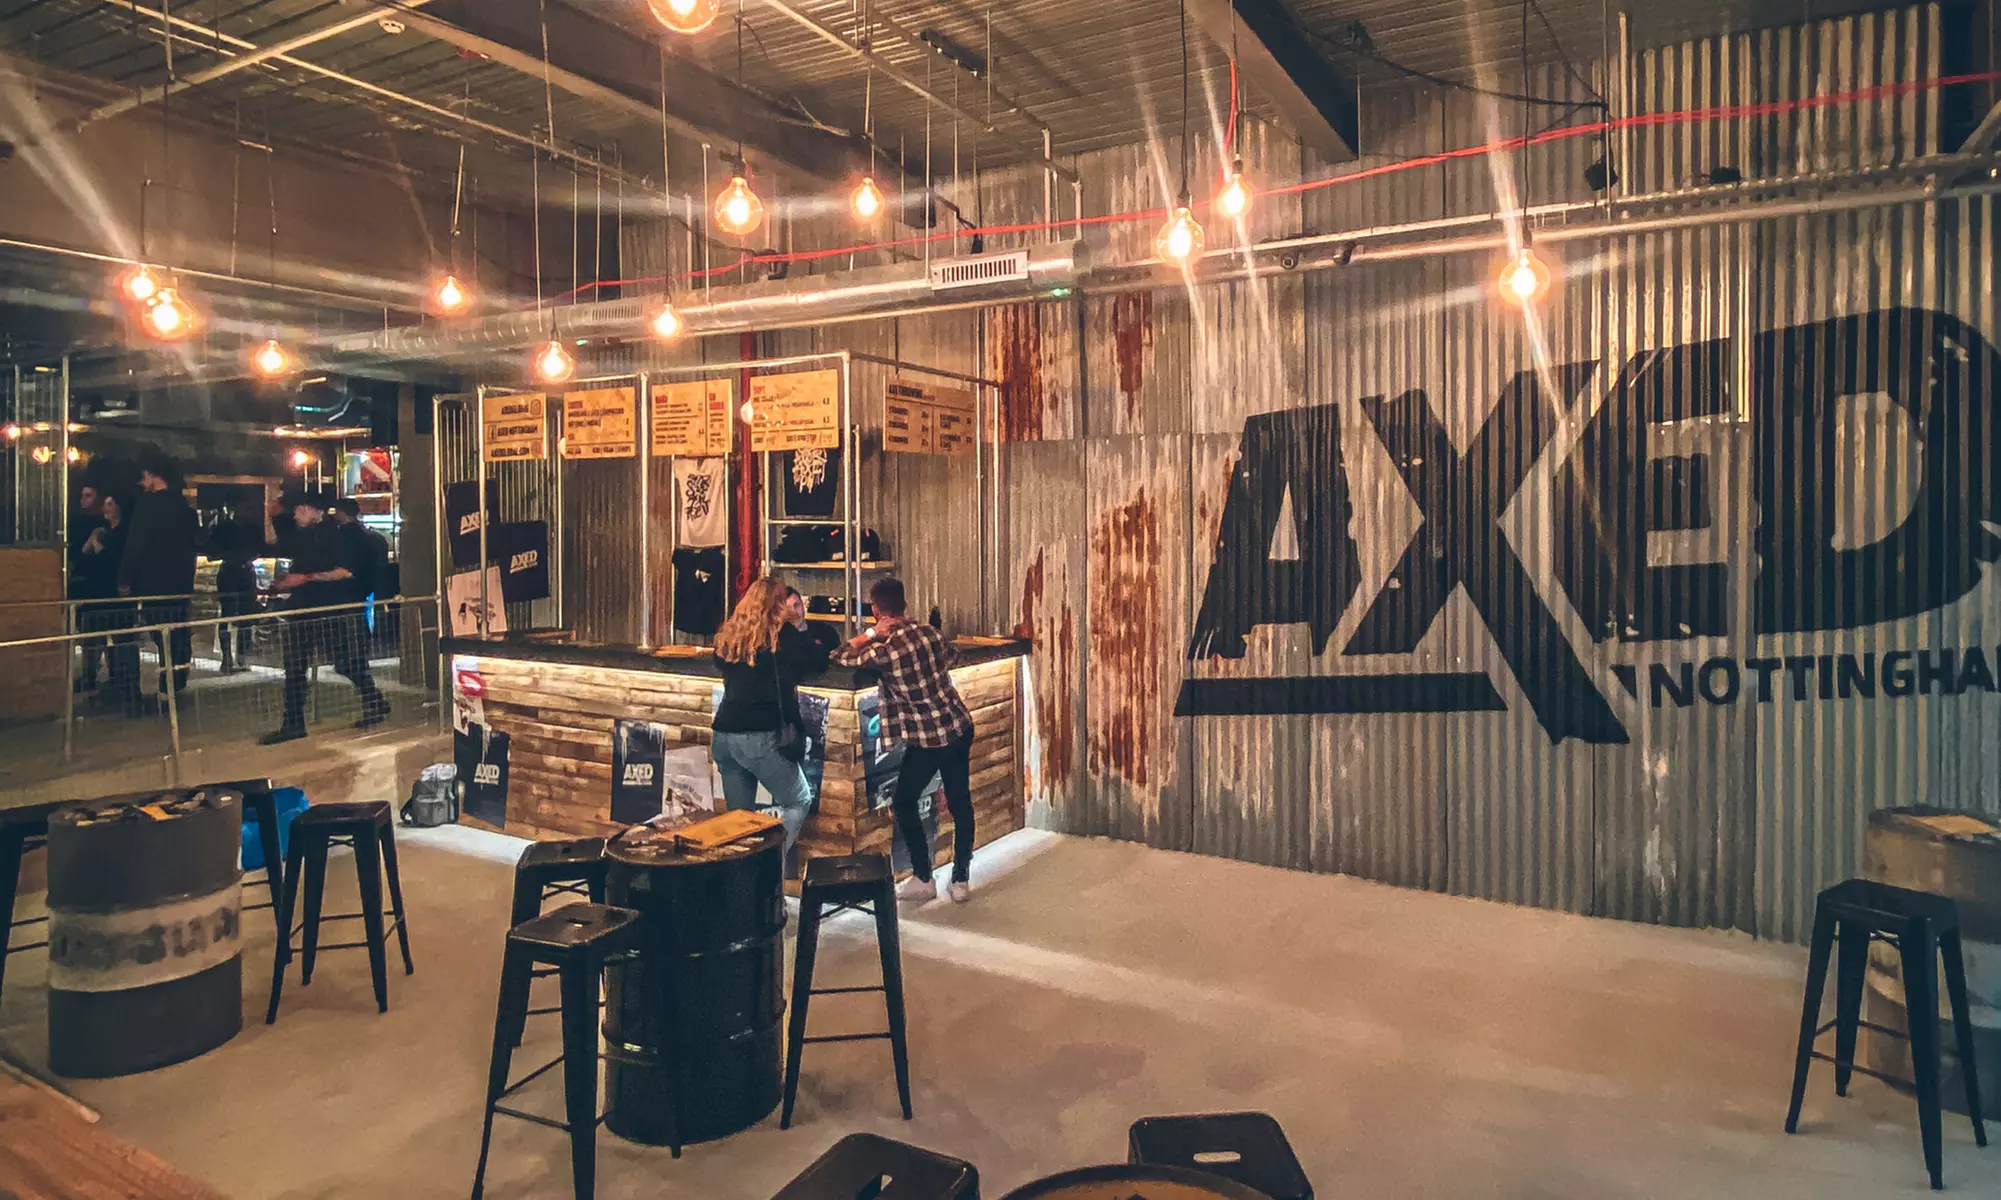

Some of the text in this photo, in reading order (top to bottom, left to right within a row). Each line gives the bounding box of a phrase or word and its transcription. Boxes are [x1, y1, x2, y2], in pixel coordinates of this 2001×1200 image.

[1180, 307, 2001, 745] AXED
[510, 549, 538, 573] AXED
[1649, 647, 2001, 708] NOTTINGHA
[474, 763, 500, 785] AXED
[623, 763, 654, 785] AXED
